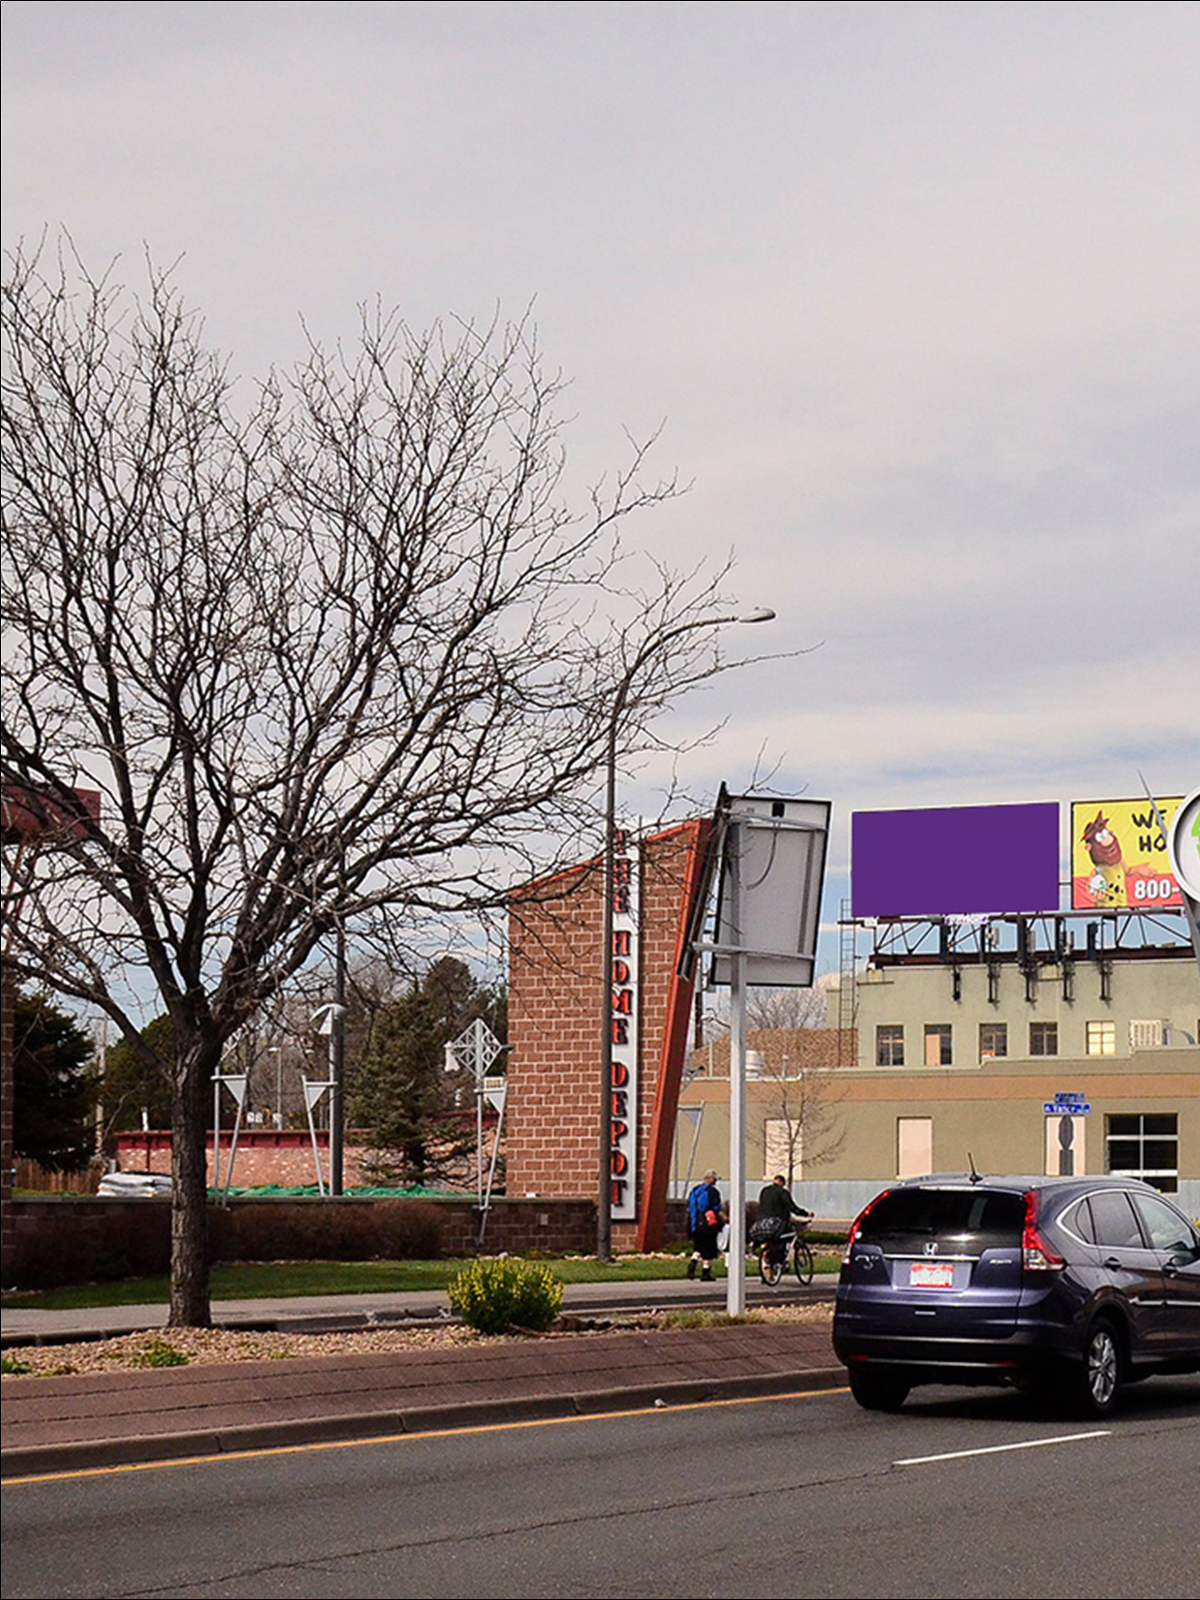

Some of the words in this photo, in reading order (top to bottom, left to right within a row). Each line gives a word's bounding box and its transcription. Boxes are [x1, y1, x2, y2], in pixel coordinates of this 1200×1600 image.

[1139, 833, 1167, 852] HO
[611, 930, 632, 1045] HOME
[610, 1061, 629, 1208] DEPOT
